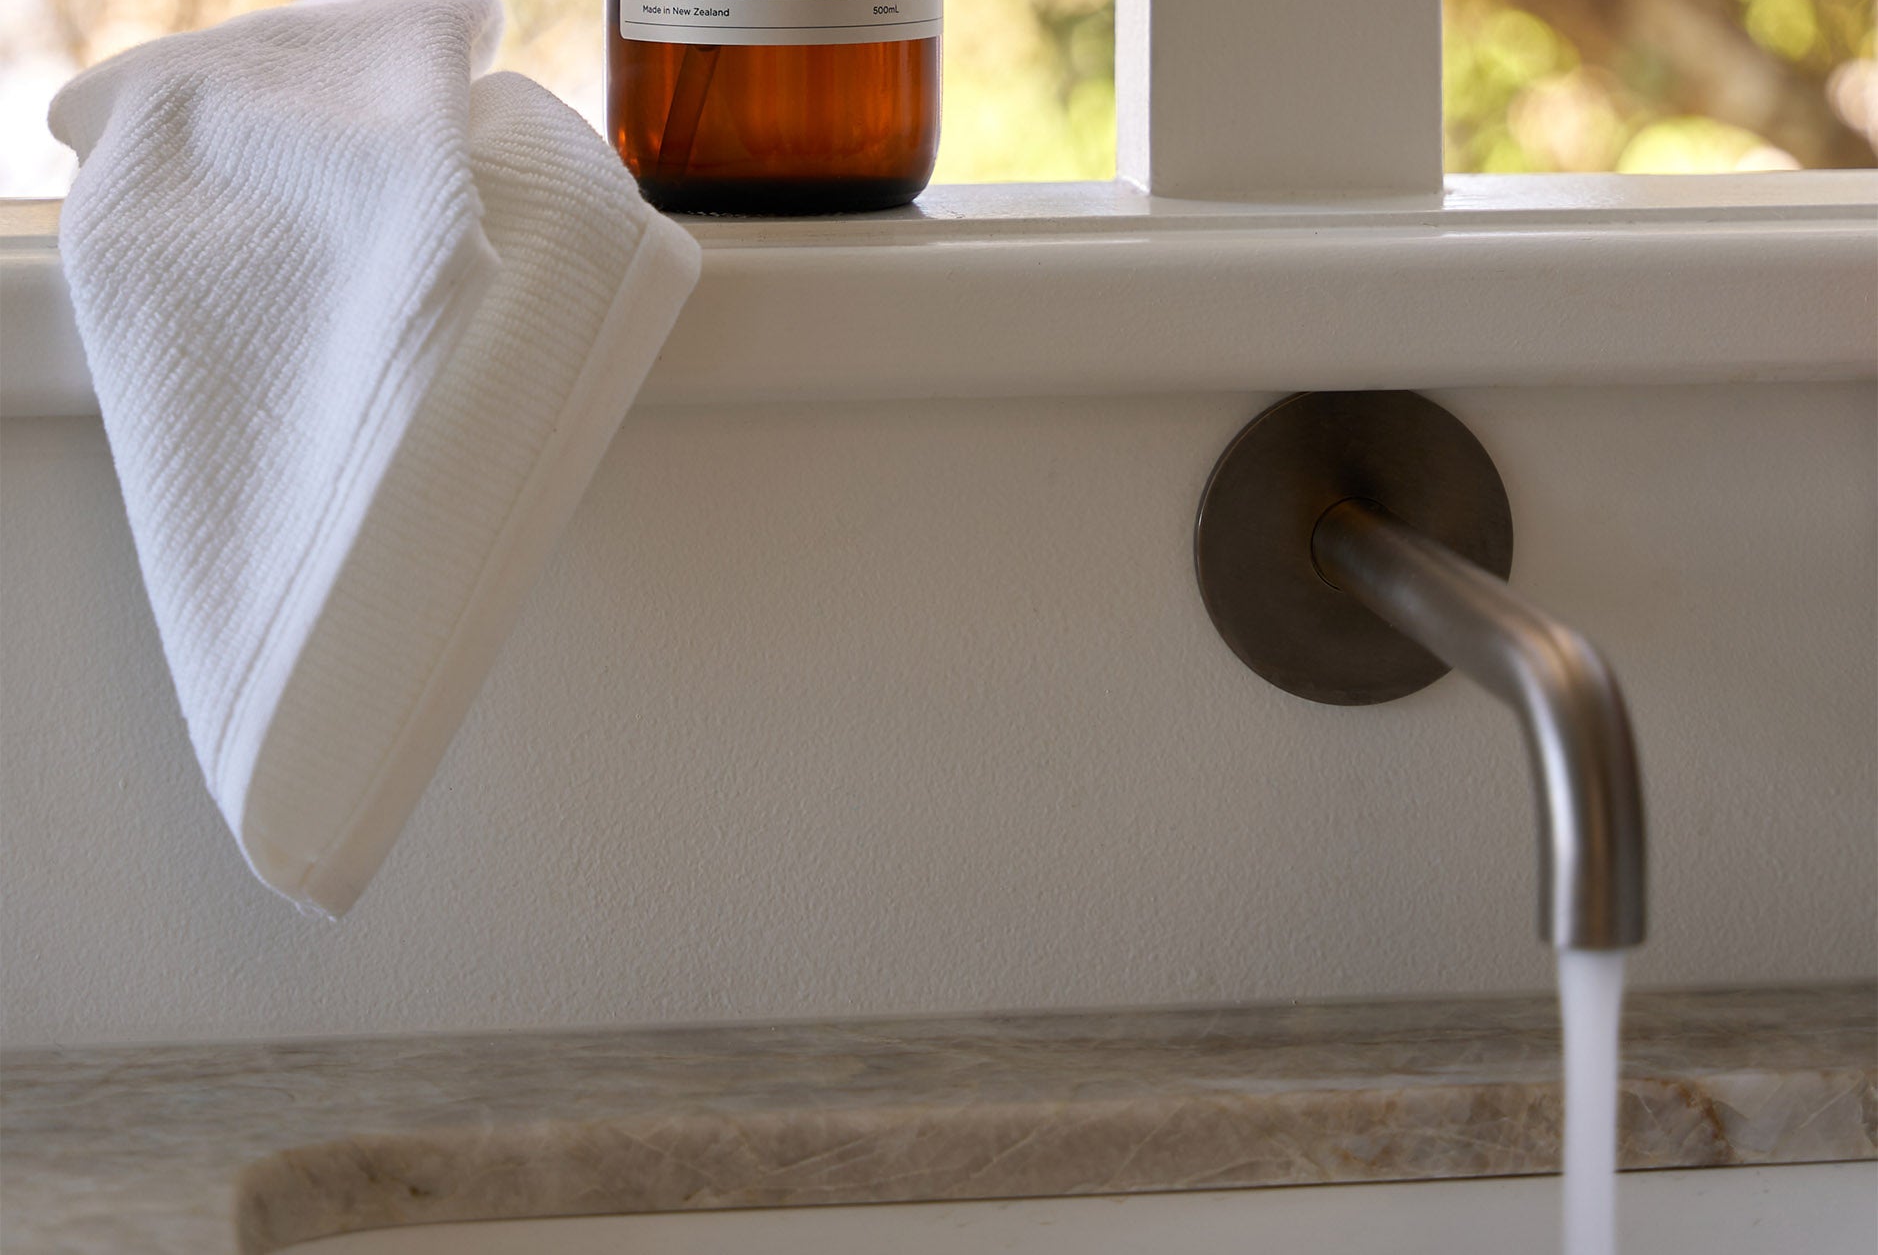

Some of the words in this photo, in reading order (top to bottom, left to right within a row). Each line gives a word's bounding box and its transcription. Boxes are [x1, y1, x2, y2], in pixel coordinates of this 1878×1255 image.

[643, 5, 661, 14] Made
[663, 6, 670, 14] in
[673, 7, 691, 15] New
[693, 8, 729, 17] Zealand
[873, 4, 899, 15] 500mL
